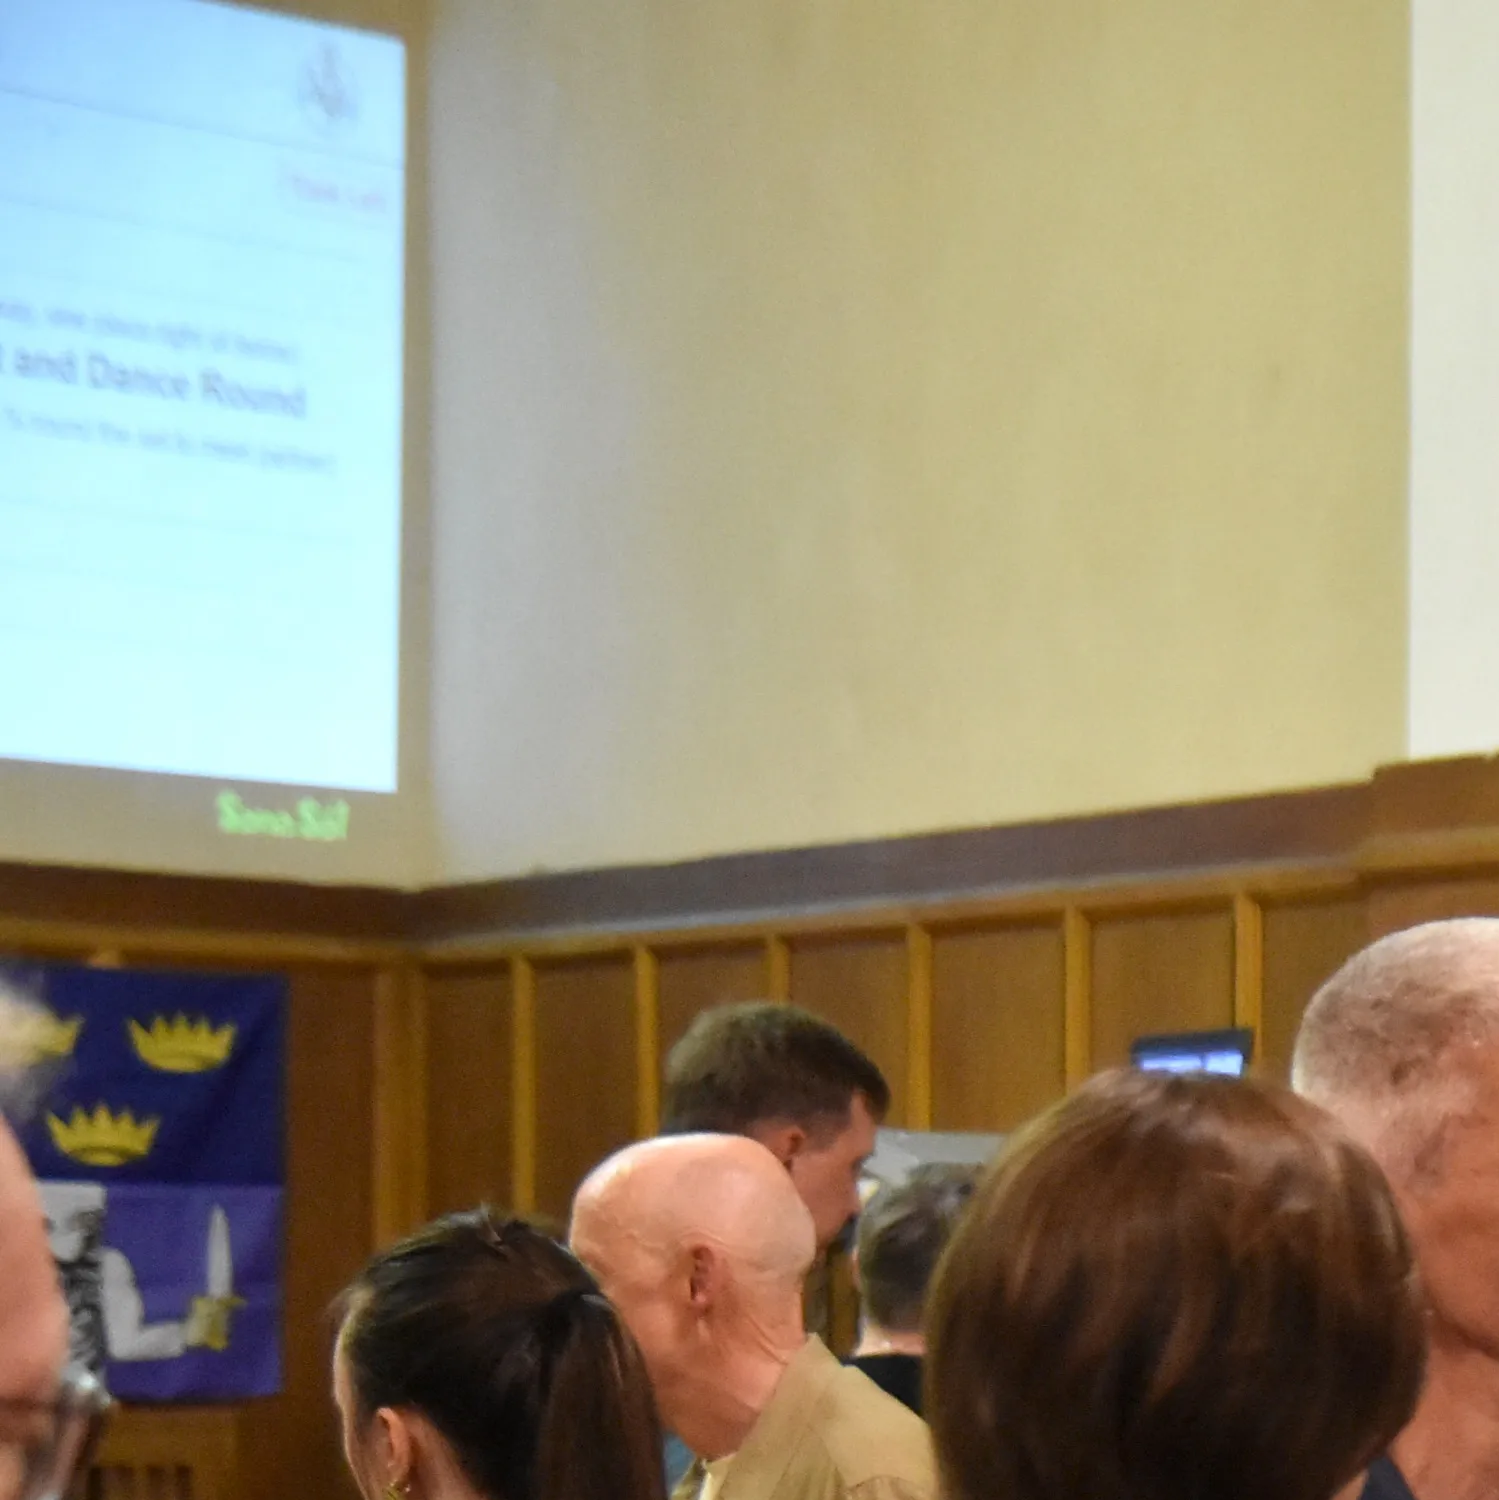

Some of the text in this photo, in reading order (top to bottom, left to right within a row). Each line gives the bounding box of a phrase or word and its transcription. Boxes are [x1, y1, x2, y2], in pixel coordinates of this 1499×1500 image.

[14, 347, 78, 384] and
[88, 352, 190, 401] Dance
[200, 368, 306, 419] Round
